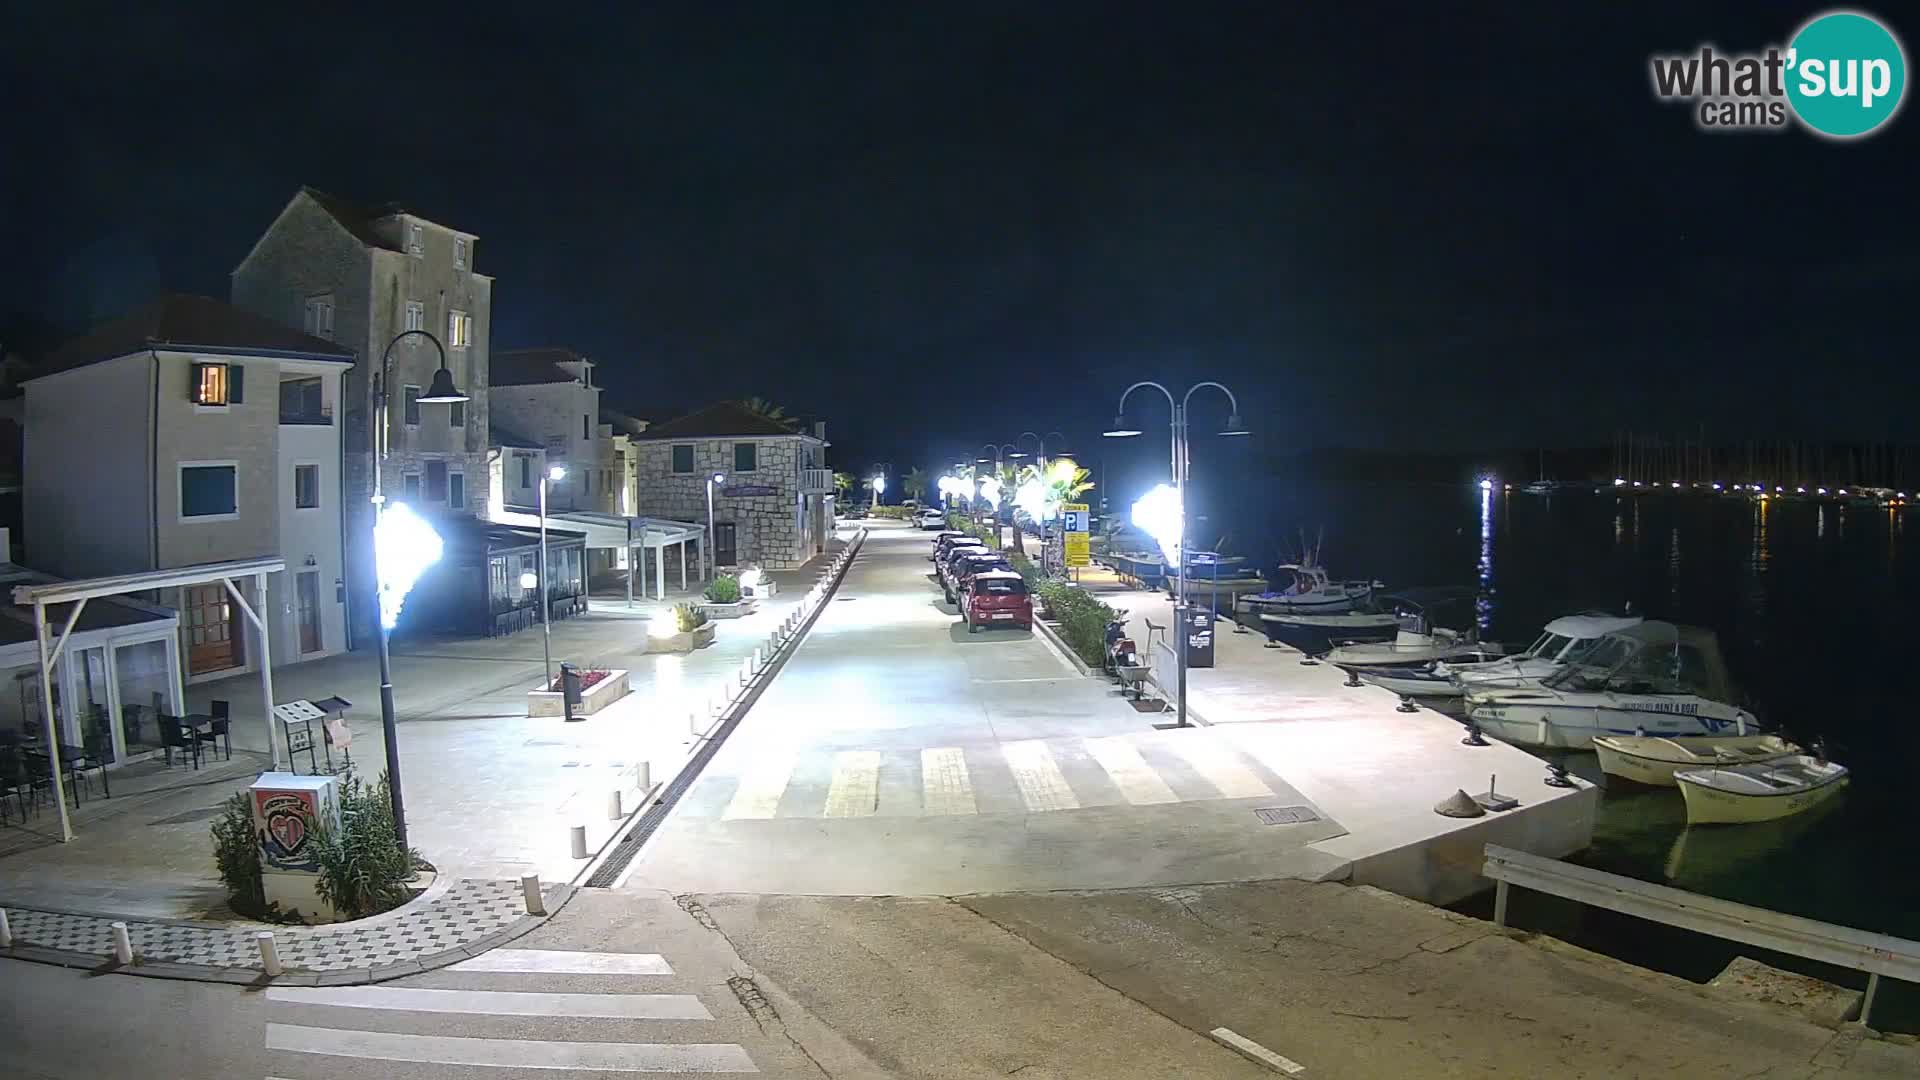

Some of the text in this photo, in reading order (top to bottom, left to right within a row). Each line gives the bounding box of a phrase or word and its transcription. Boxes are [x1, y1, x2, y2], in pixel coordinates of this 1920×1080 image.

[1065, 513, 1076, 530] P
[1655, 702, 1673, 713] RENT
[1681, 703, 1698, 715] BOAT
